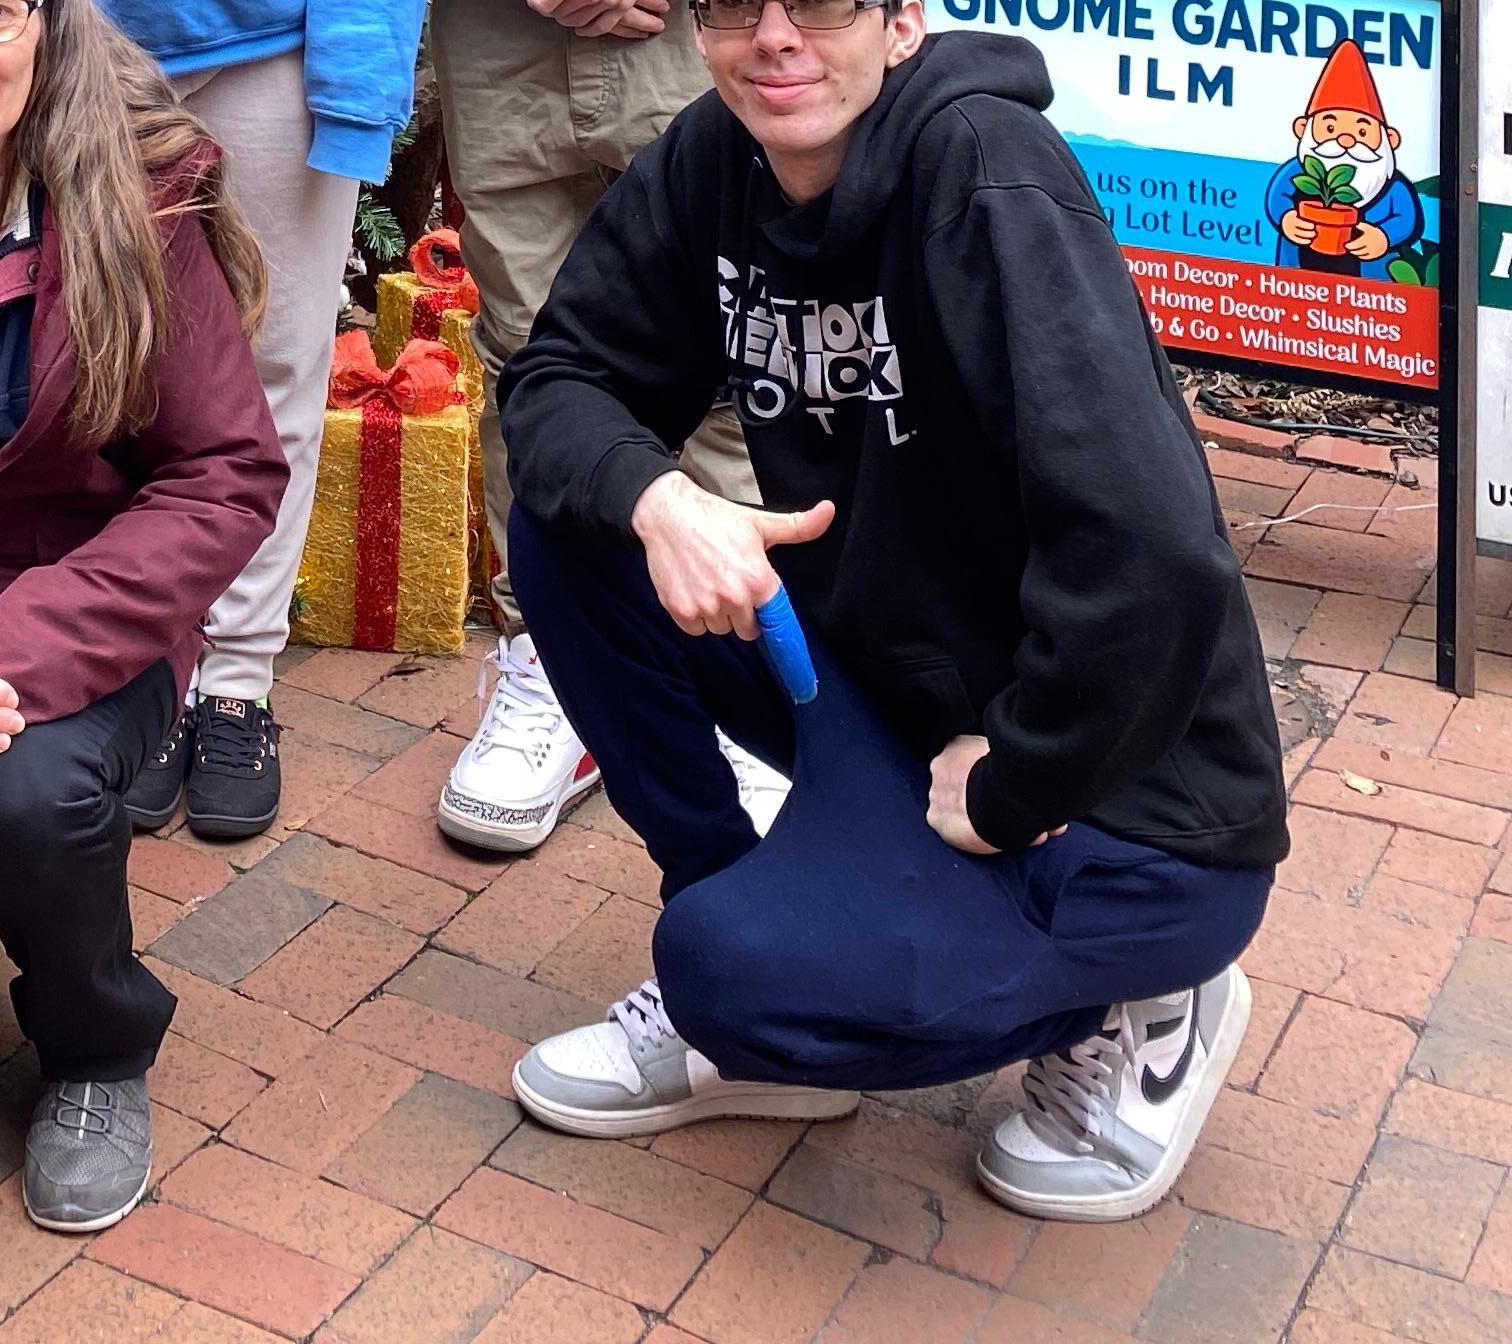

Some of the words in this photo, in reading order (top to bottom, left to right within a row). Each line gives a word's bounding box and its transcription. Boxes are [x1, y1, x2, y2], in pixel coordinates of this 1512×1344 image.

[1118, 54, 1234, 107] ILM
[1097, 172, 1131, 195] us
[1140, 178, 1178, 202] on
[1187, 178, 1238, 209] the
[1126, 203, 1172, 234] Lot
[1182, 210, 1263, 247] Level
[1150, 284, 1214, 313] Home
[1220, 295, 1286, 323] Decor
[1306, 309, 1401, 342] Slushies
[1174, 261, 1239, 289] Decor
[1259, 273, 1329, 303] House
[1336, 284, 1407, 314] Plants
[1169, 316, 1185, 338] &
[1190, 318, 1219, 341] Go
[1239, 326, 1359, 364] Whimsical
[1364, 347, 1436, 378] Magic
